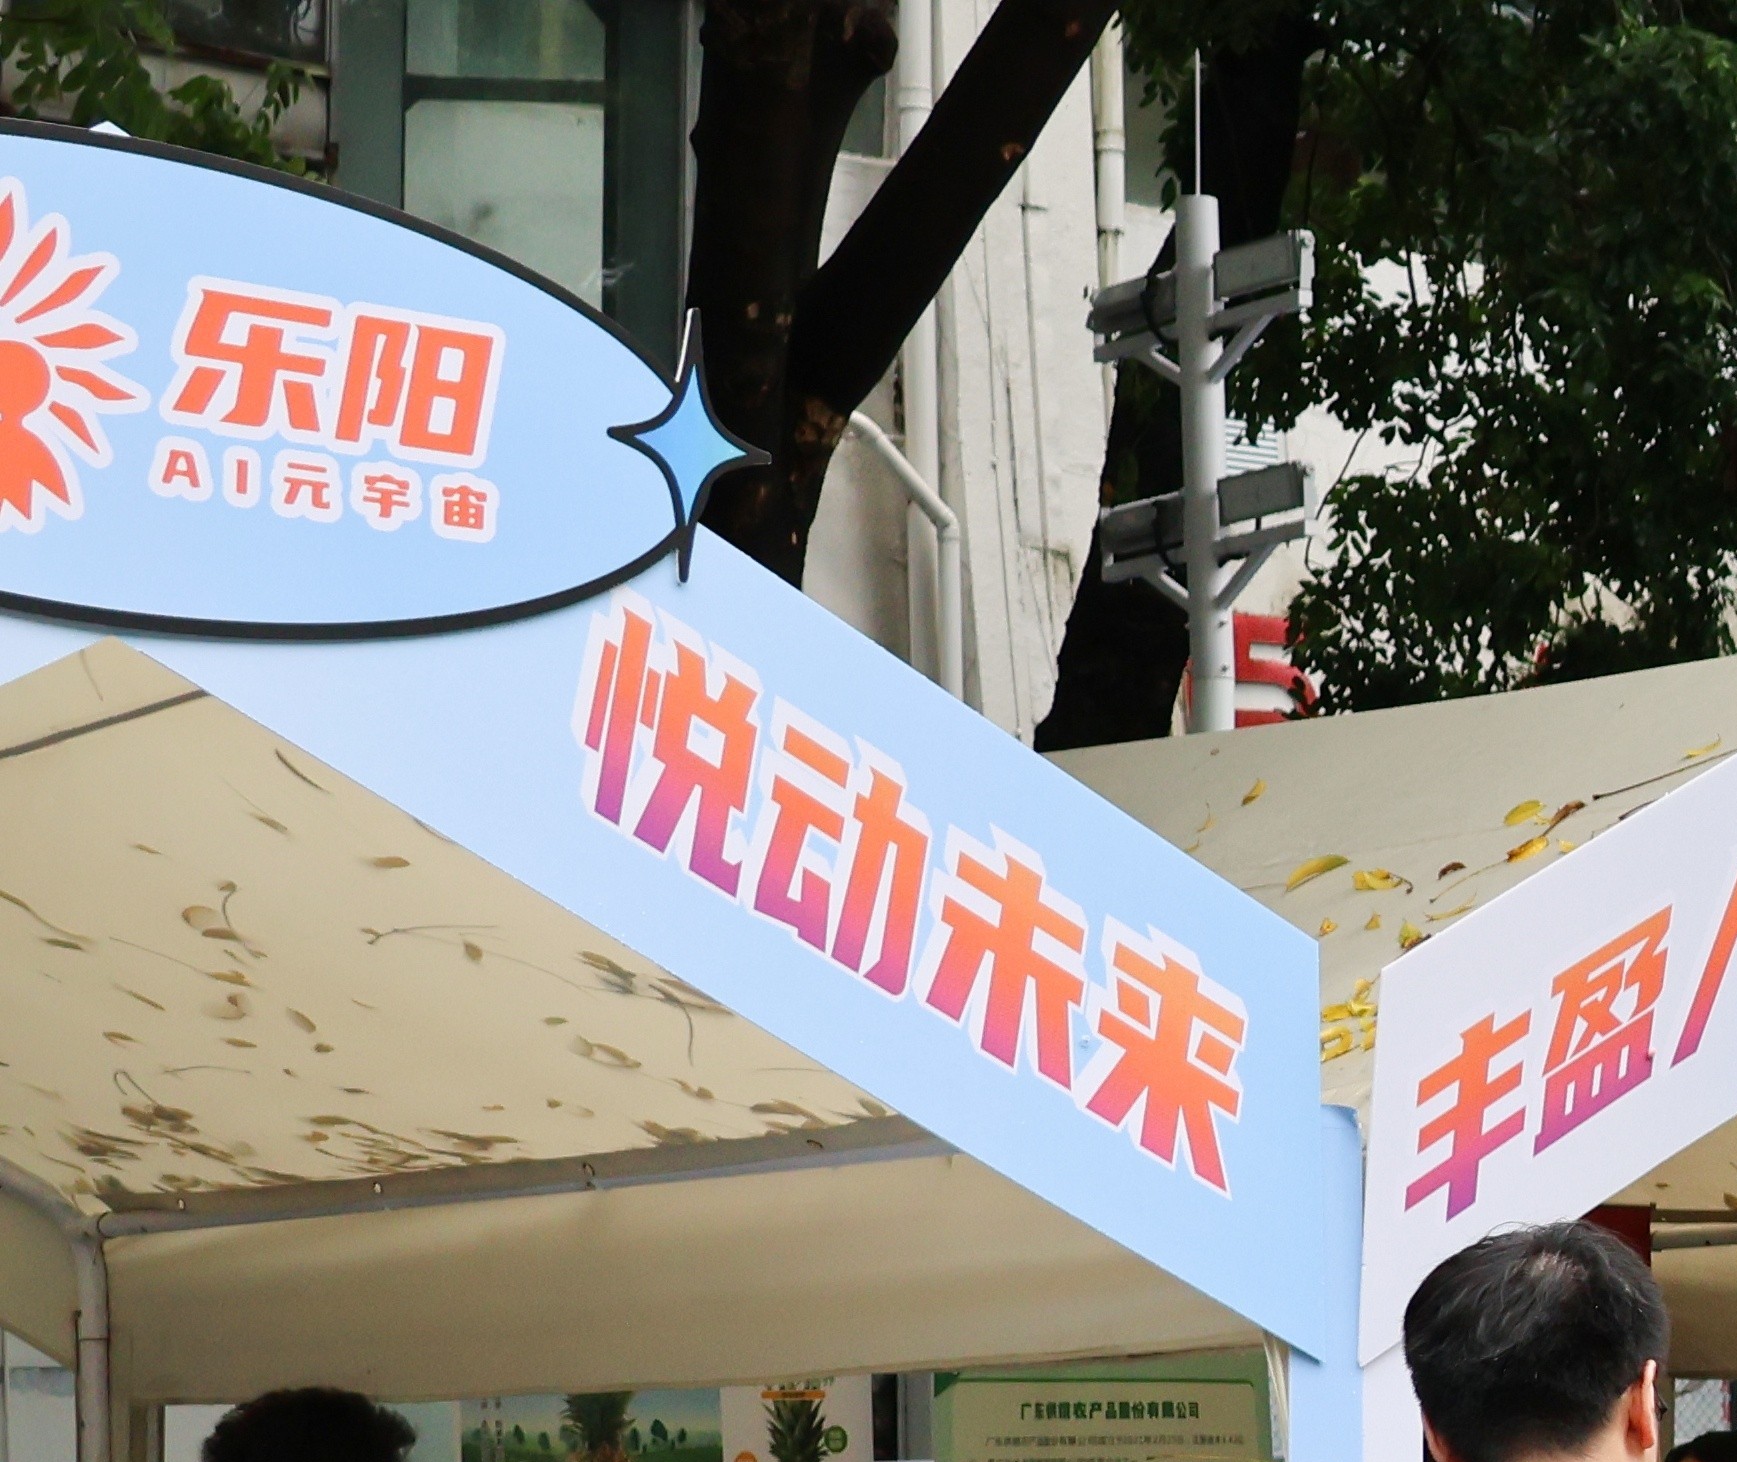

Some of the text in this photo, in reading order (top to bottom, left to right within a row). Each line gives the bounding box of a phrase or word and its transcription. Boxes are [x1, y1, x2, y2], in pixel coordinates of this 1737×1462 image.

[172, 288, 494, 458] 乐阳
[584, 606, 1245, 1195] 悦动未来
